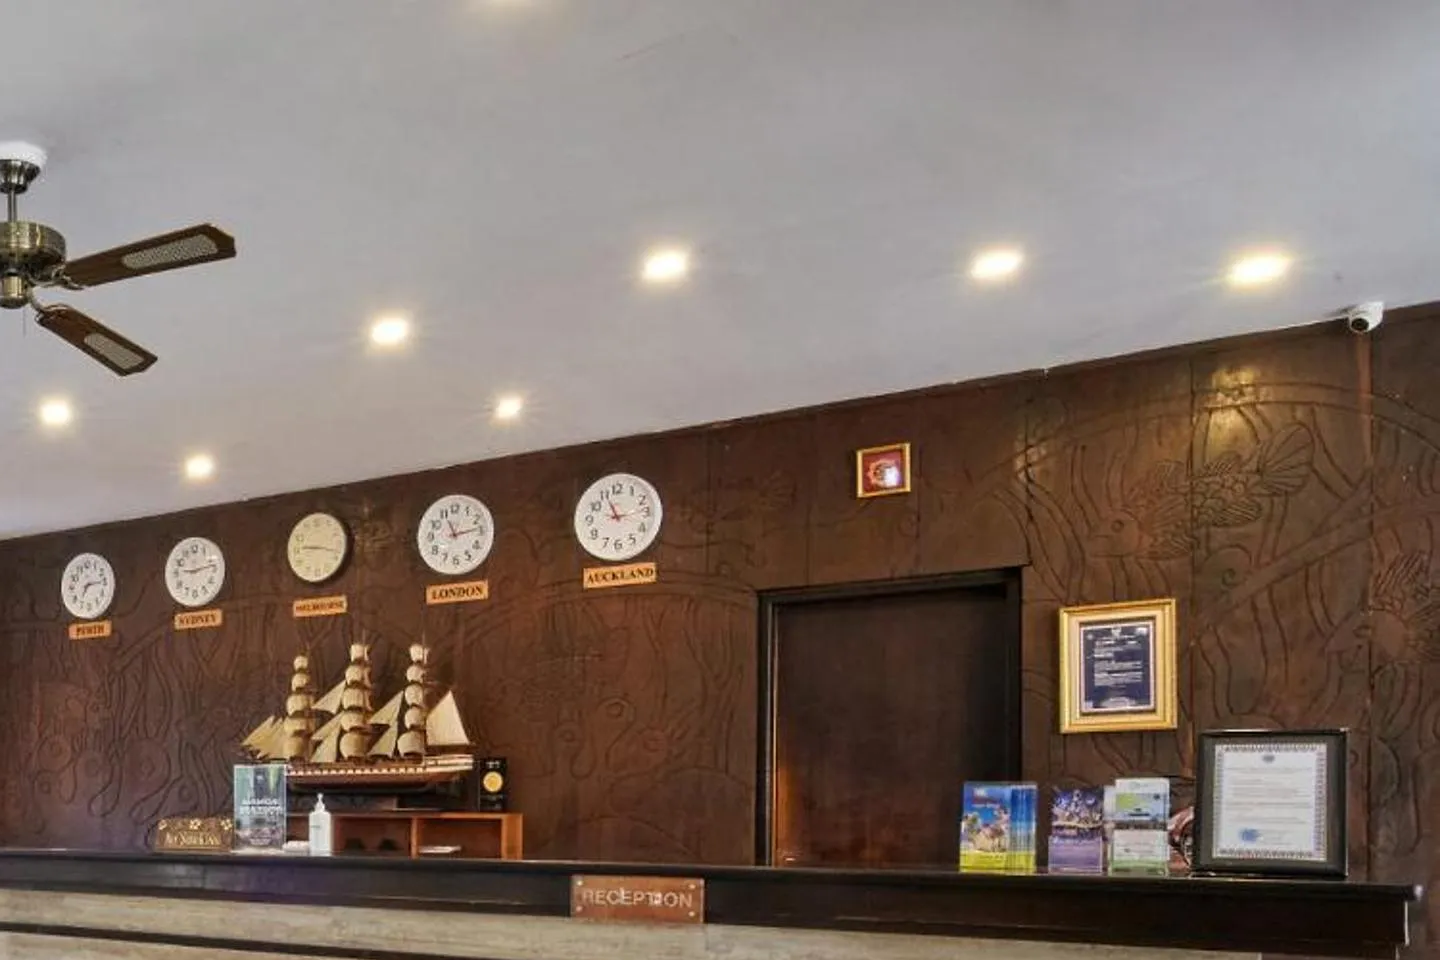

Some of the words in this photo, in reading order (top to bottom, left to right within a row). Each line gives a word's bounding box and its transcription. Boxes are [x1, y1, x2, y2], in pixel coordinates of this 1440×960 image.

[612, 483, 623, 495] 12
[630, 485, 634, 496] 1
[600, 490, 609, 500] 11
[639, 494, 646, 505] 2
[451, 504, 459, 514] 12
[466, 506, 470, 516] 1
[591, 501, 601, 512] 10
[440, 509, 448, 519] 11
[642, 507, 650, 518] 3
[432, 520, 441, 529] 10
[473, 514, 480, 525] 2
[586, 515, 593, 526] 9
[639, 522, 646, 532] 4
[427, 531, 434, 541] 9
[591, 528, 598, 539] 8
[628, 533, 635, 544] 5
[472, 540, 481, 549] 4
[603, 537, 610, 548] 7
[614, 540, 622, 550] 6
[432, 545, 438, 555] 8
[464, 550, 471, 560] 5
[442, 552, 448, 561] 7
[452, 555, 459, 566] 6
[588, 568, 653, 583] AUCKLAND
[432, 585, 484, 600] LONDON
[179, 614, 218, 626] SYDNEY
[582, 887, 693, 908] RECEPTION
